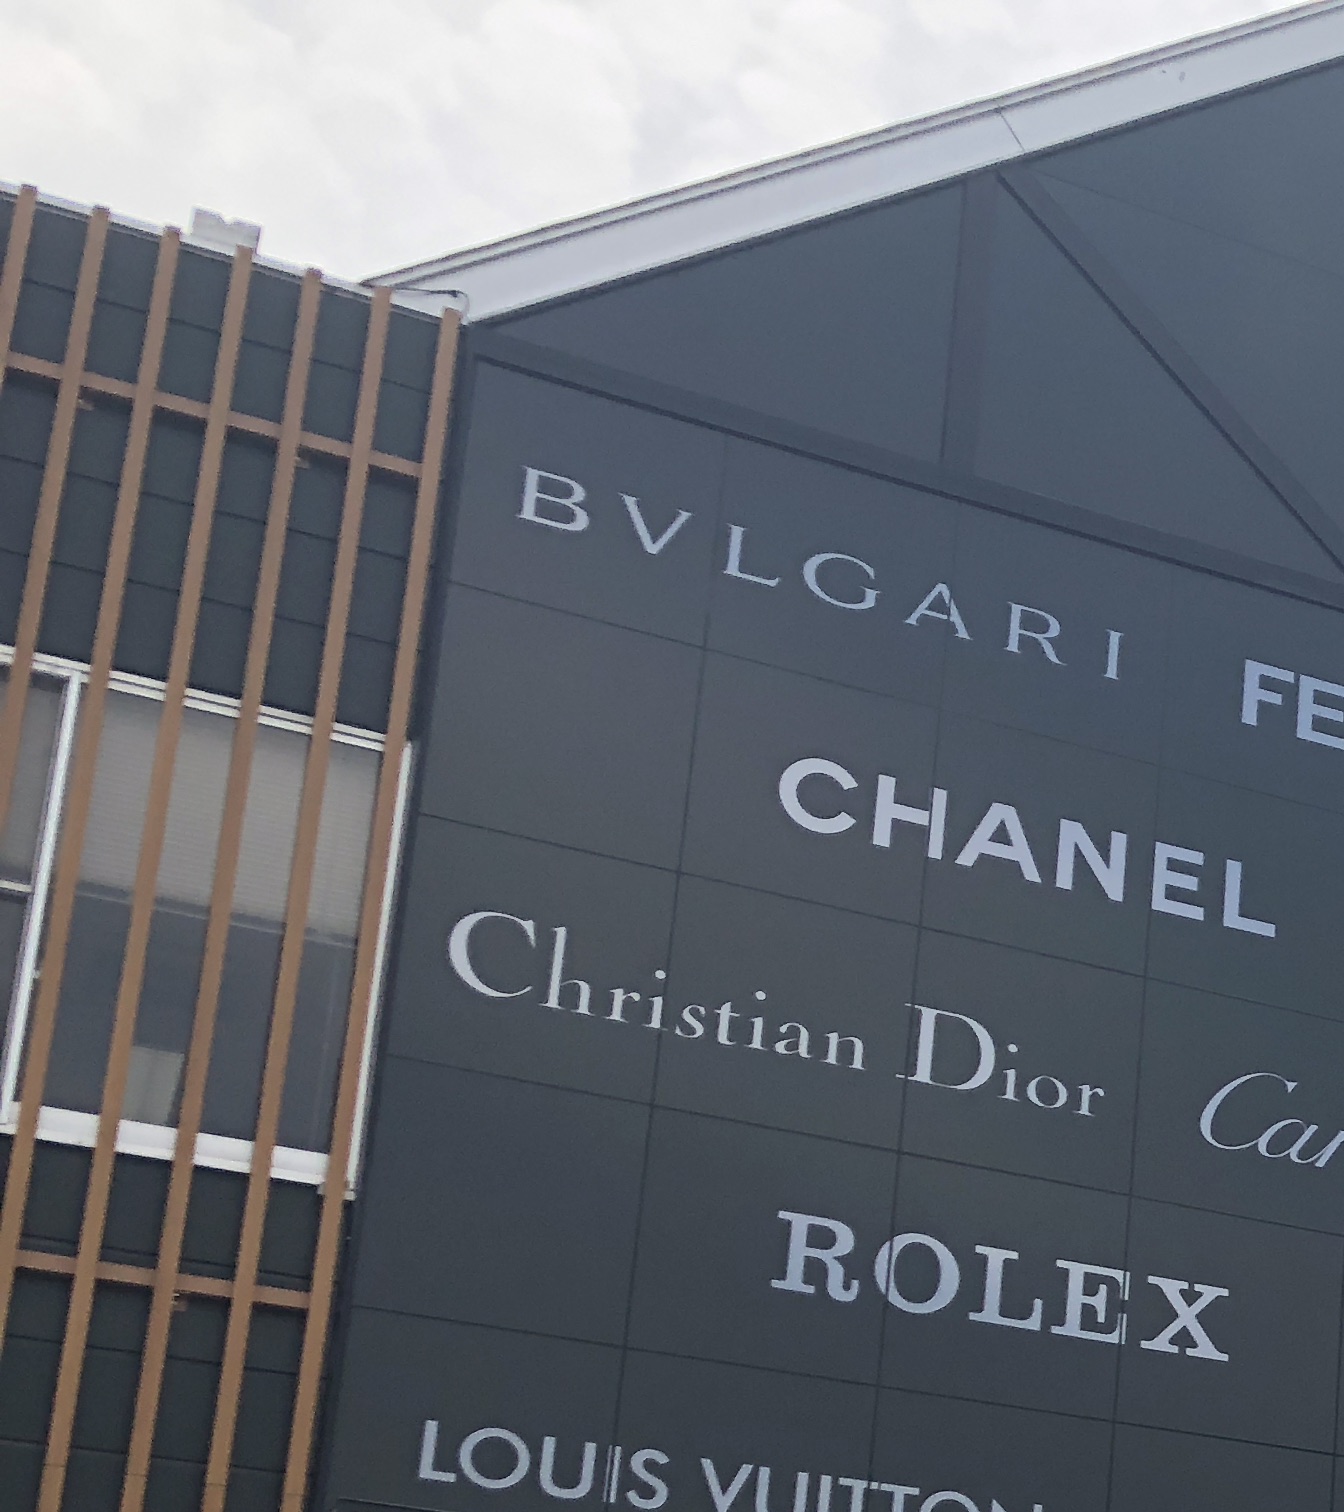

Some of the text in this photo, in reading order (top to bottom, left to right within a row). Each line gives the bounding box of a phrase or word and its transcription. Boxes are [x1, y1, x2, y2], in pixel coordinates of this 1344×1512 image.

[518, 465, 1124, 681] BVLGARI
[778, 757, 1276, 938] CHANEL
[448, 911, 1106, 1115] Christian Dior
[770, 1210, 1230, 1362] ROLEX
[418, 1419, 670, 1511] LOUIS
